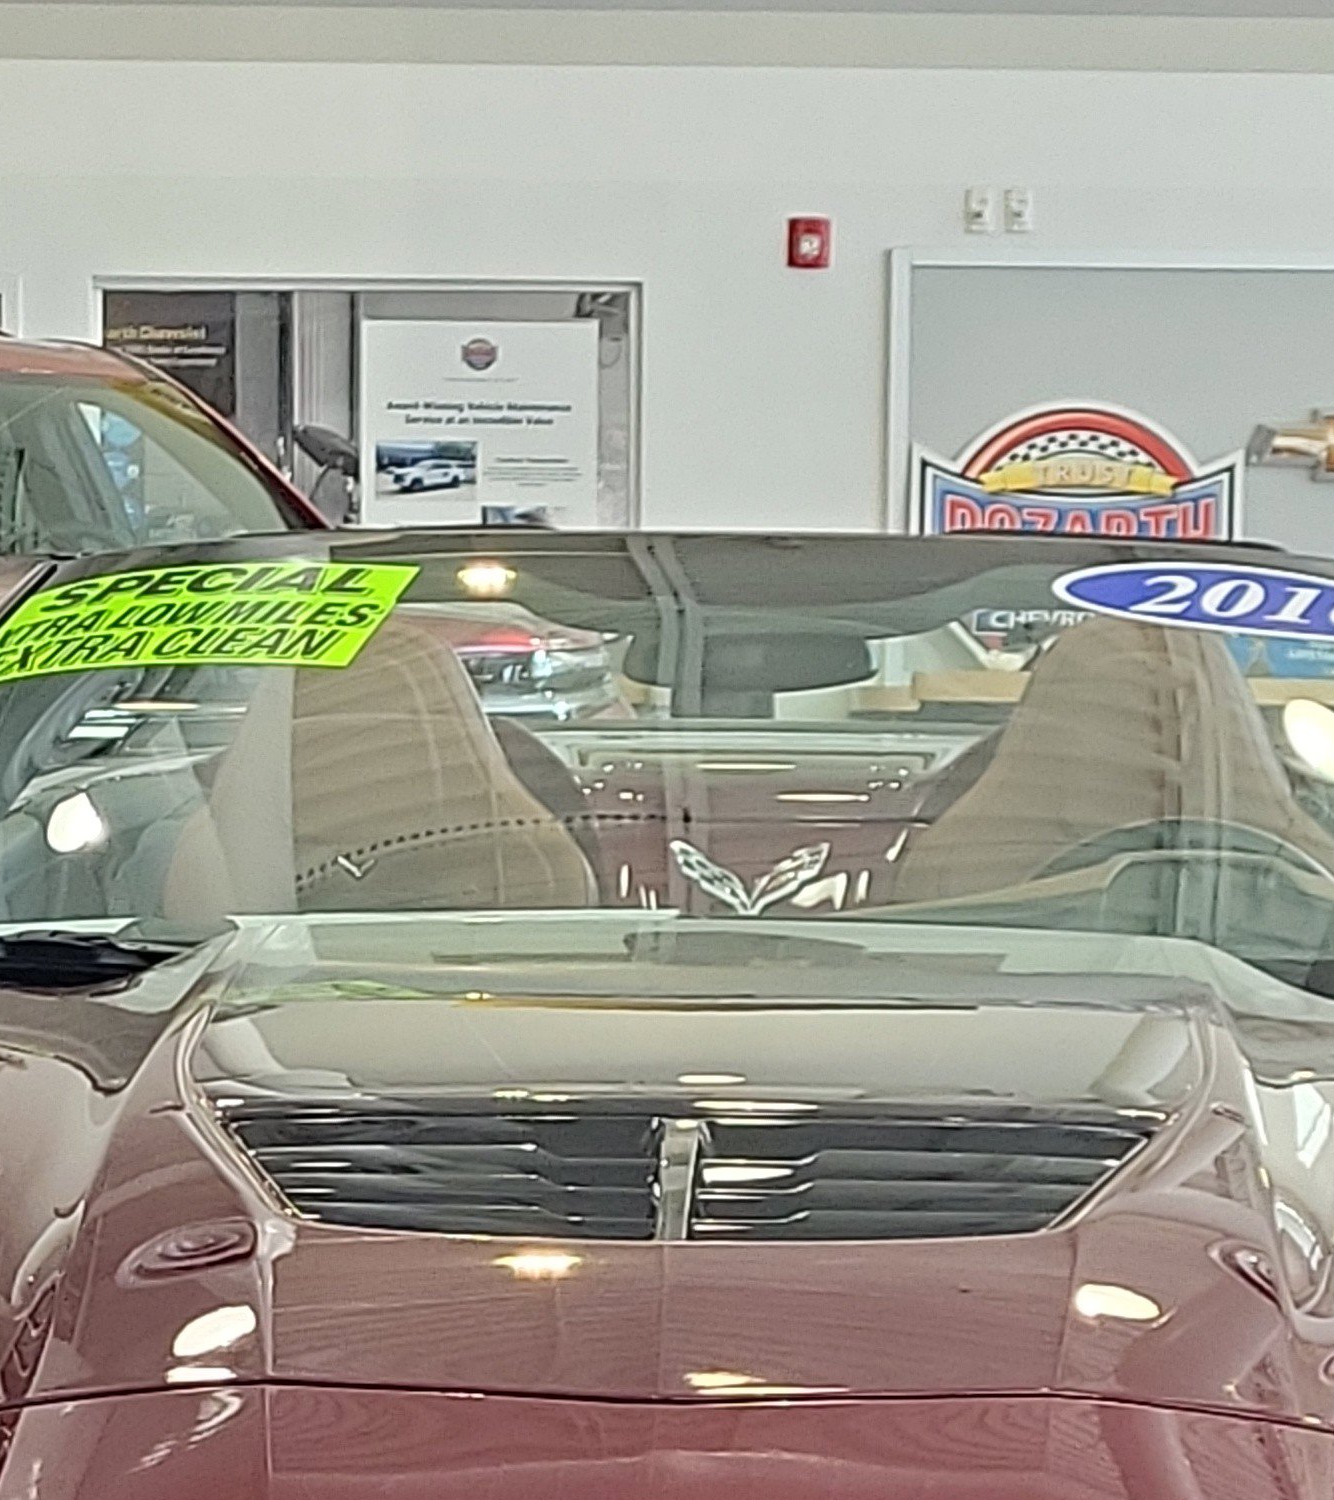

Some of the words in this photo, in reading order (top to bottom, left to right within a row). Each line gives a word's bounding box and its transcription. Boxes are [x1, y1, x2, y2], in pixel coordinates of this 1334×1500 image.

[1039, 461, 1135, 481] TRUST
[40, 566, 375, 614] SPECIAL
[155, 624, 347, 660] CLEAN
